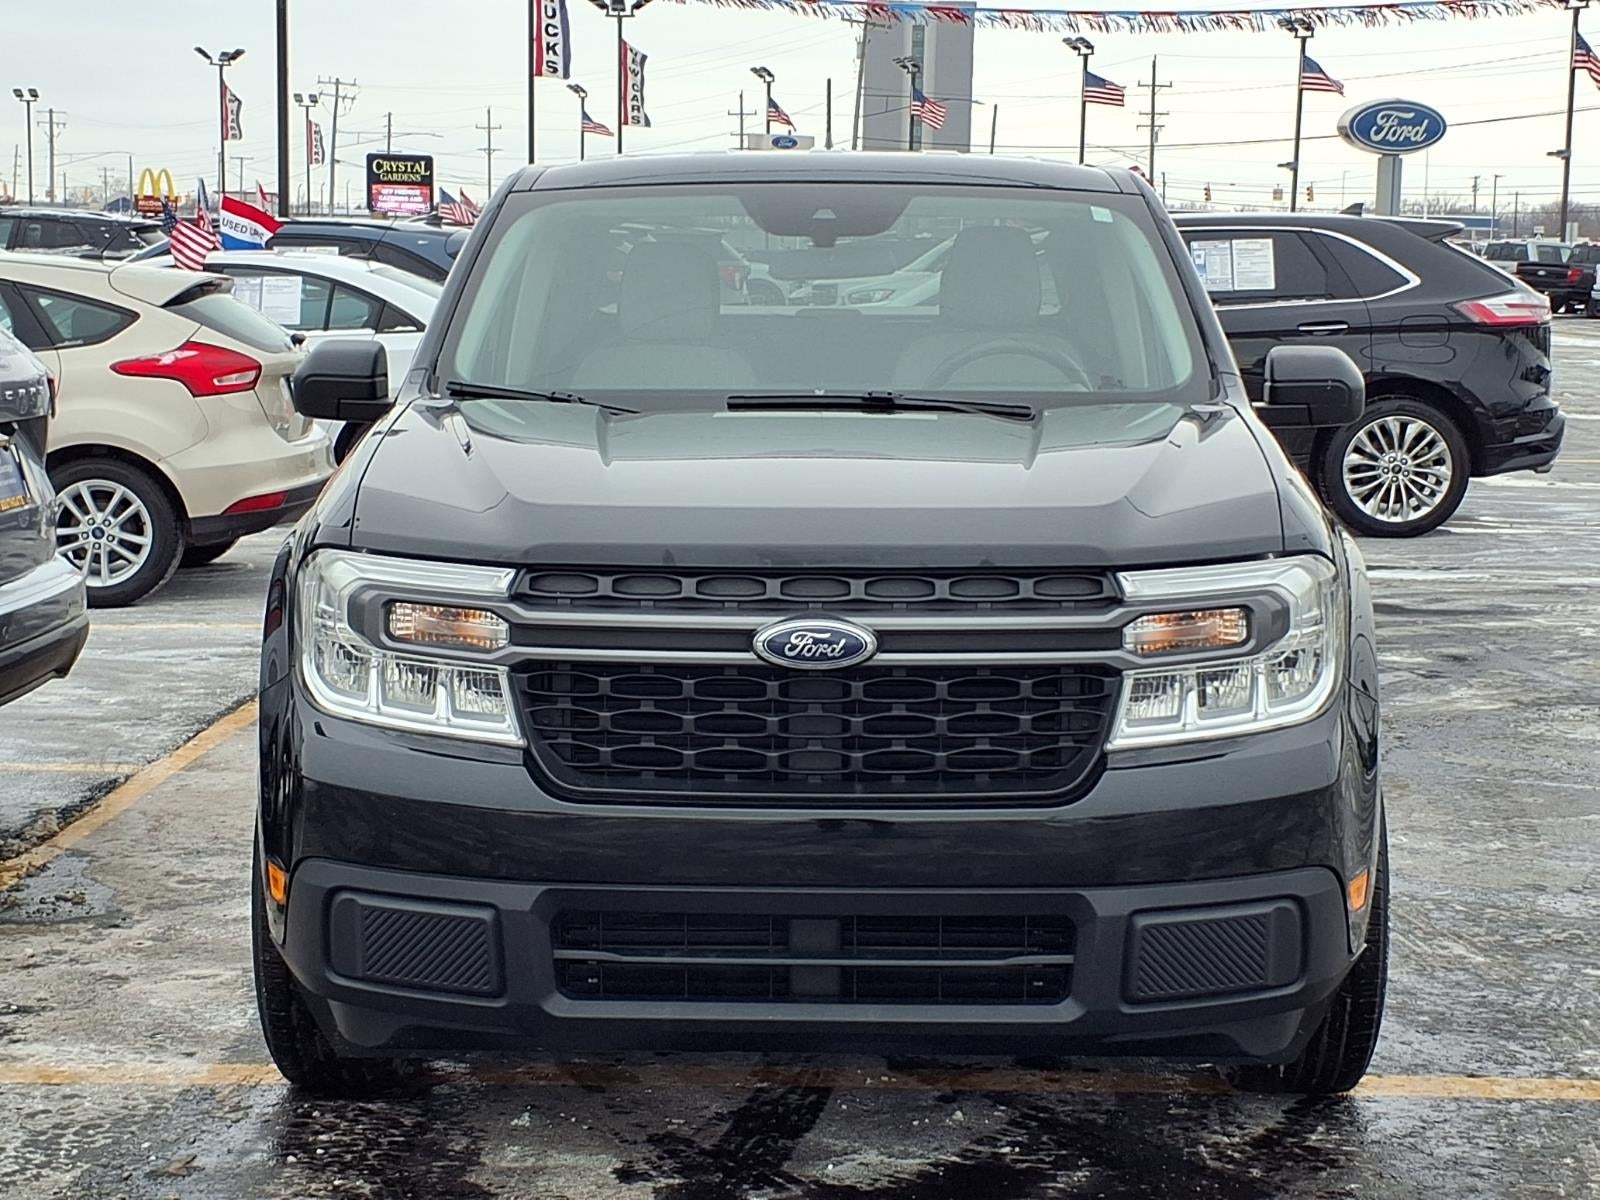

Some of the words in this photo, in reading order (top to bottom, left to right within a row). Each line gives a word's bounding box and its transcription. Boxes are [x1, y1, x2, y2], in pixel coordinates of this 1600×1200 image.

[544, 0, 560, 74] UCKS
[631, 83, 641, 124] CARS
[1369, 110, 1429, 142] Ford
[372, 159, 430, 175] CRYSTAL
[380, 172, 421, 181] GARDENS
[222, 217, 248, 234] USED
[784, 631, 846, 657] Ford
